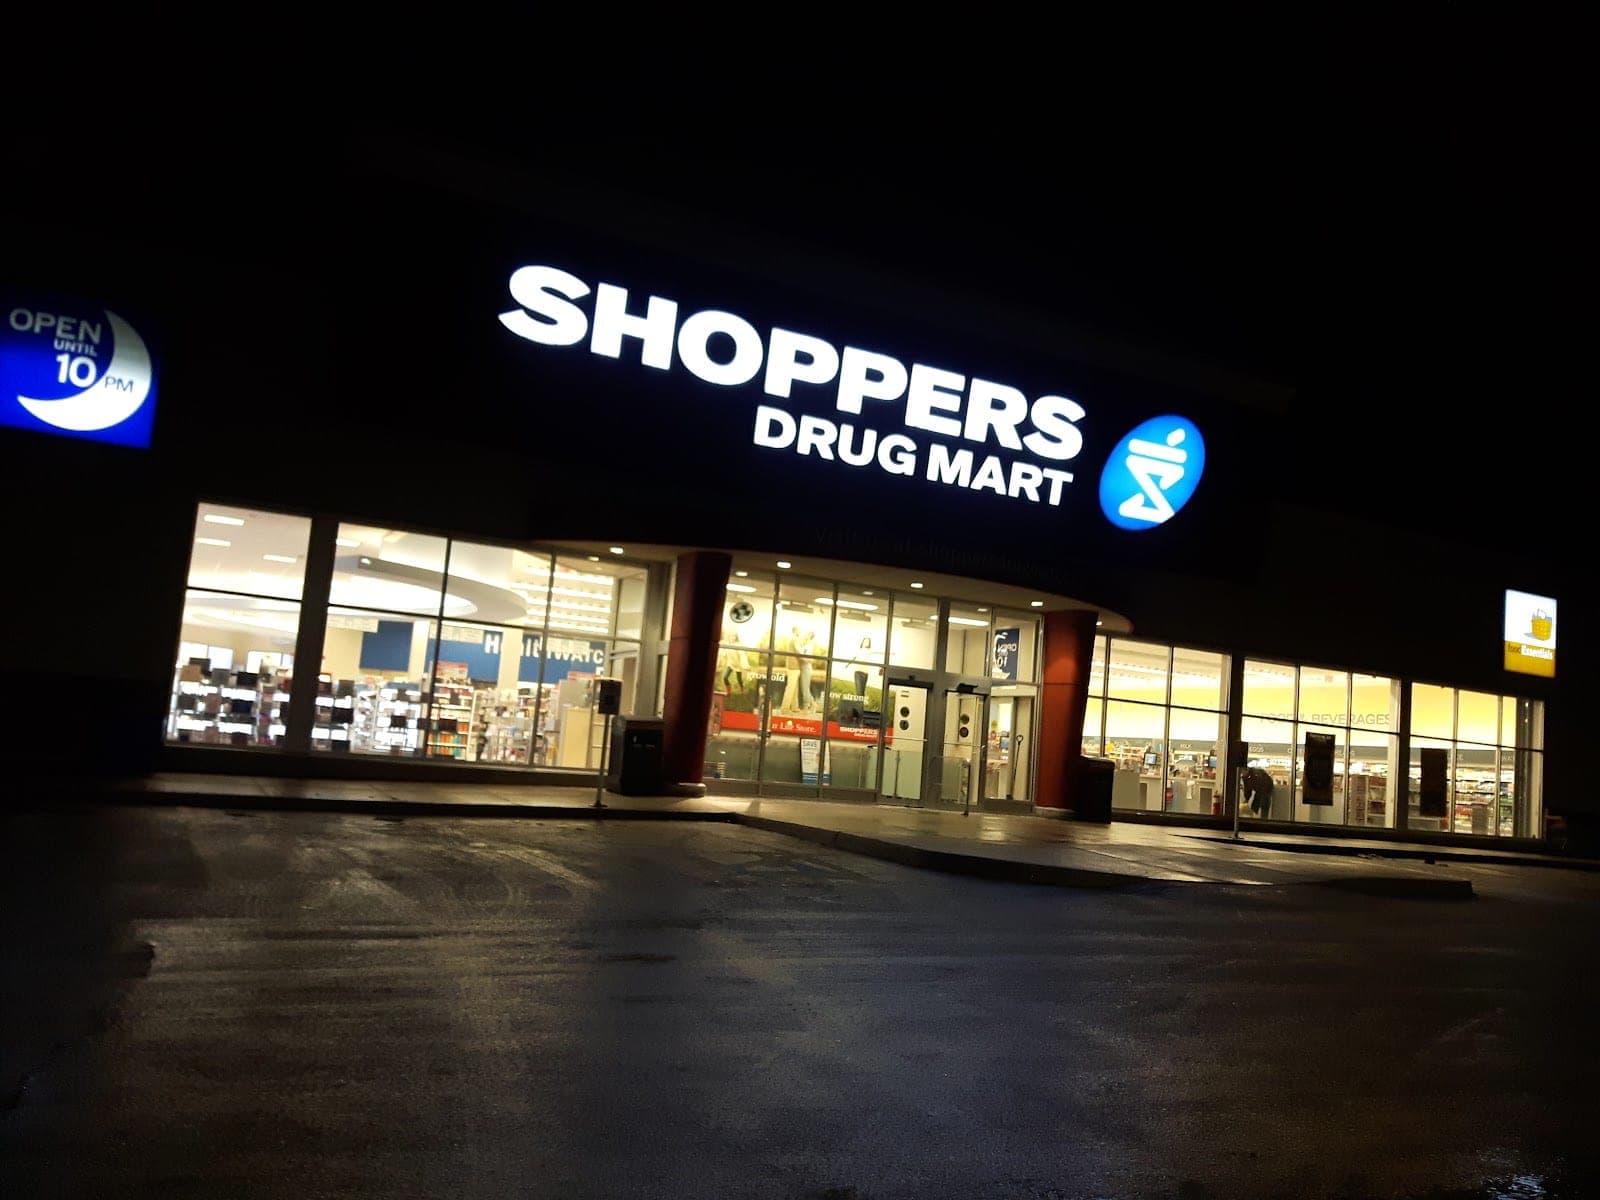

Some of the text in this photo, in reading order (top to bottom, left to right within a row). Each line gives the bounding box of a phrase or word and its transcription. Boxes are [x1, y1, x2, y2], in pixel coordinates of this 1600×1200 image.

[9, 308, 102, 344] OPEN
[54, 338, 97, 357] UNTIL
[498, 265, 1086, 460] SHOPPERS
[56, 353, 134, 393] 10 PM
[753, 405, 1074, 506] DRUG MART
[1311, 713, 1391, 725] BEVERAGES
